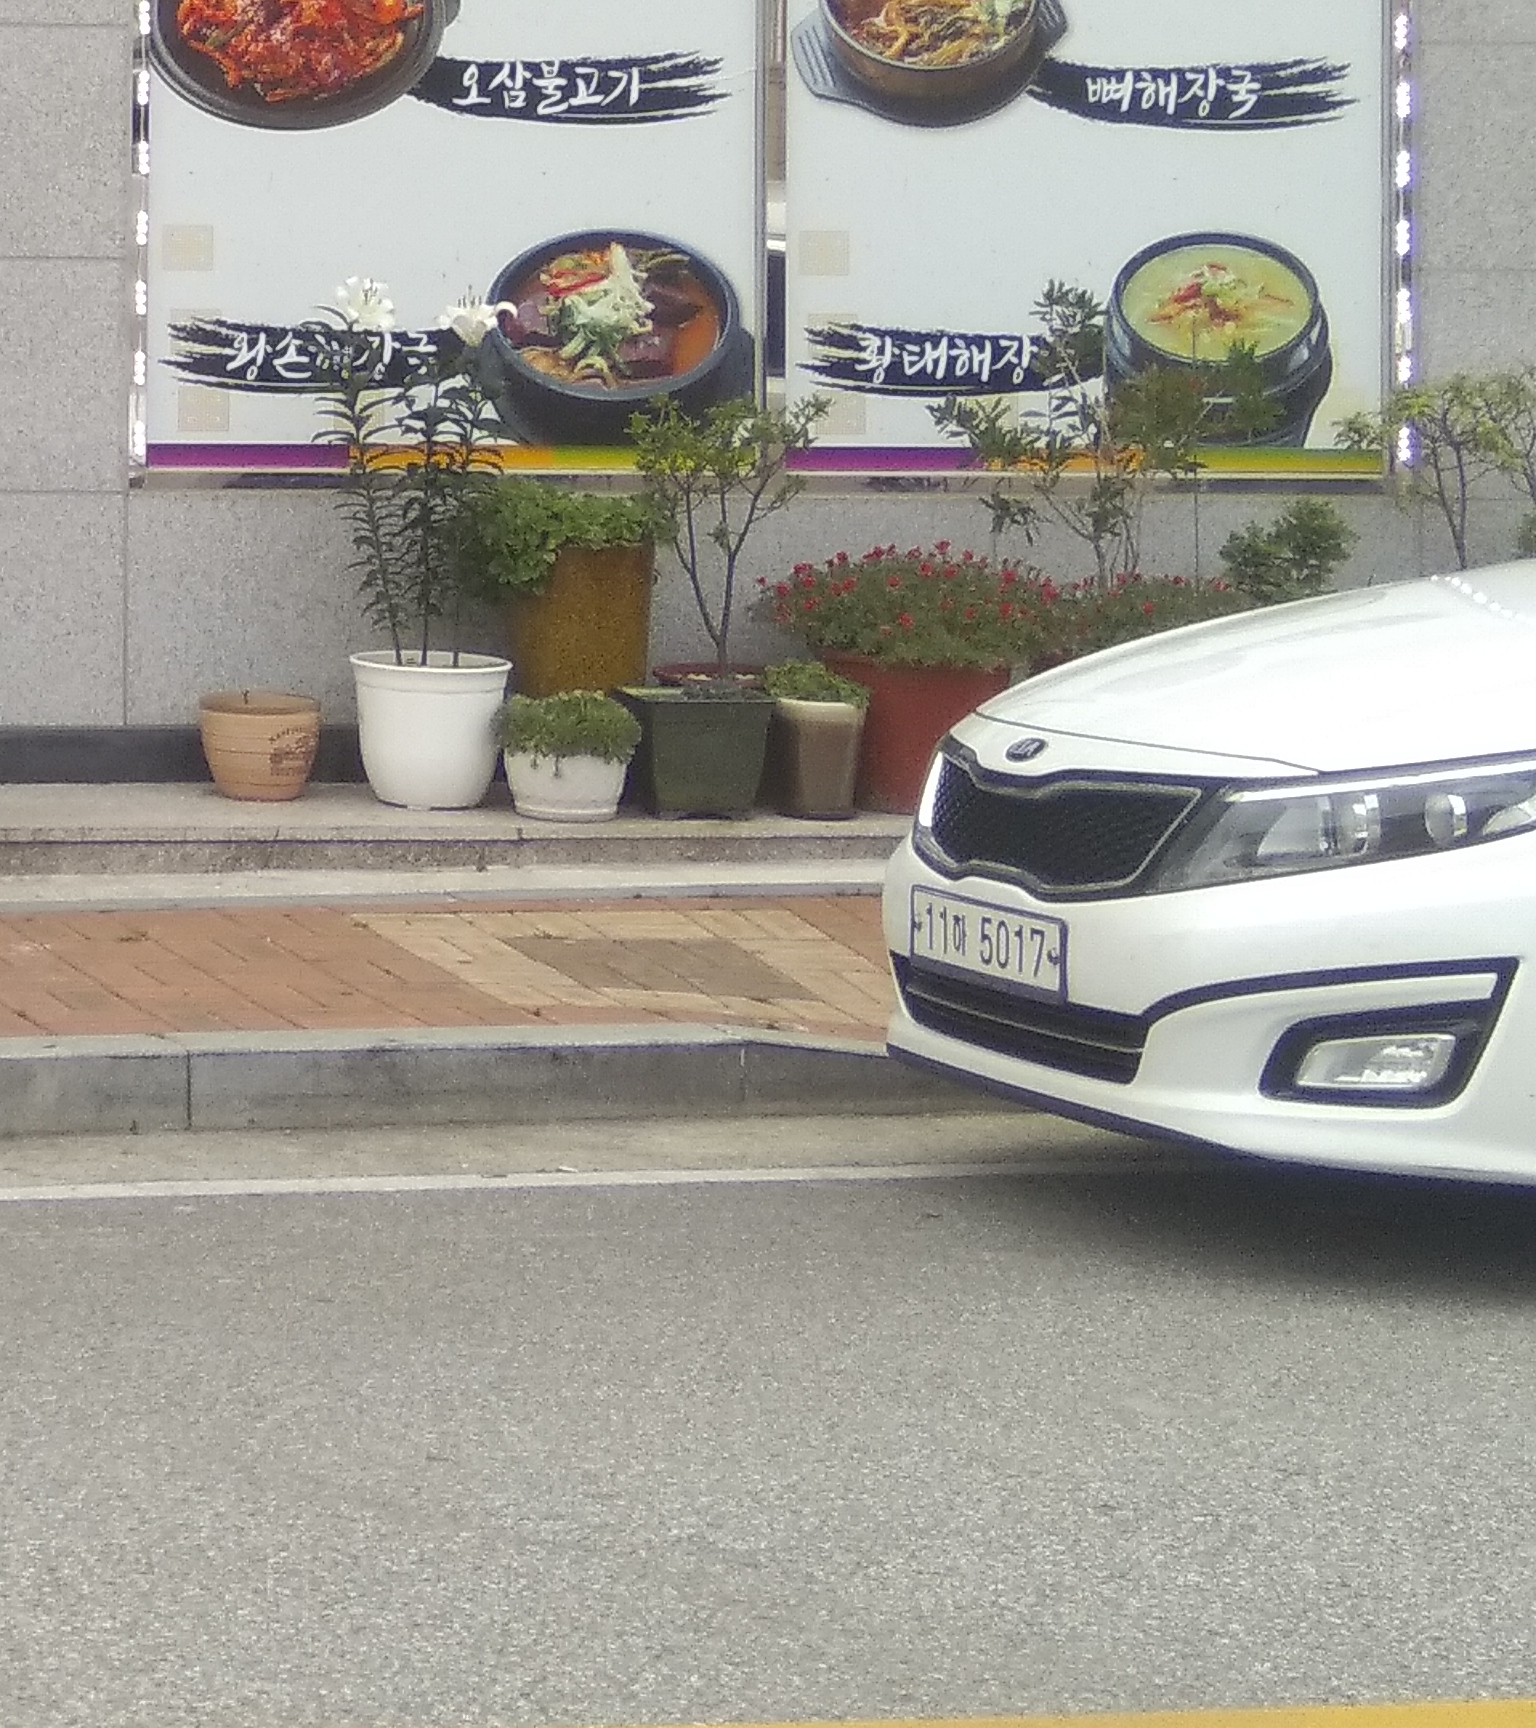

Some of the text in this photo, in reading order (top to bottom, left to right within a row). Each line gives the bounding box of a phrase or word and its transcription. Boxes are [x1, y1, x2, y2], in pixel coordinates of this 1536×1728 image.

[452, 62, 643, 115] 오삼불고기
[1085, 69, 1261, 119] 뼈해장국
[855, 334, 1071, 386] 황태해장
[980, 916, 1045, 978] 5017
